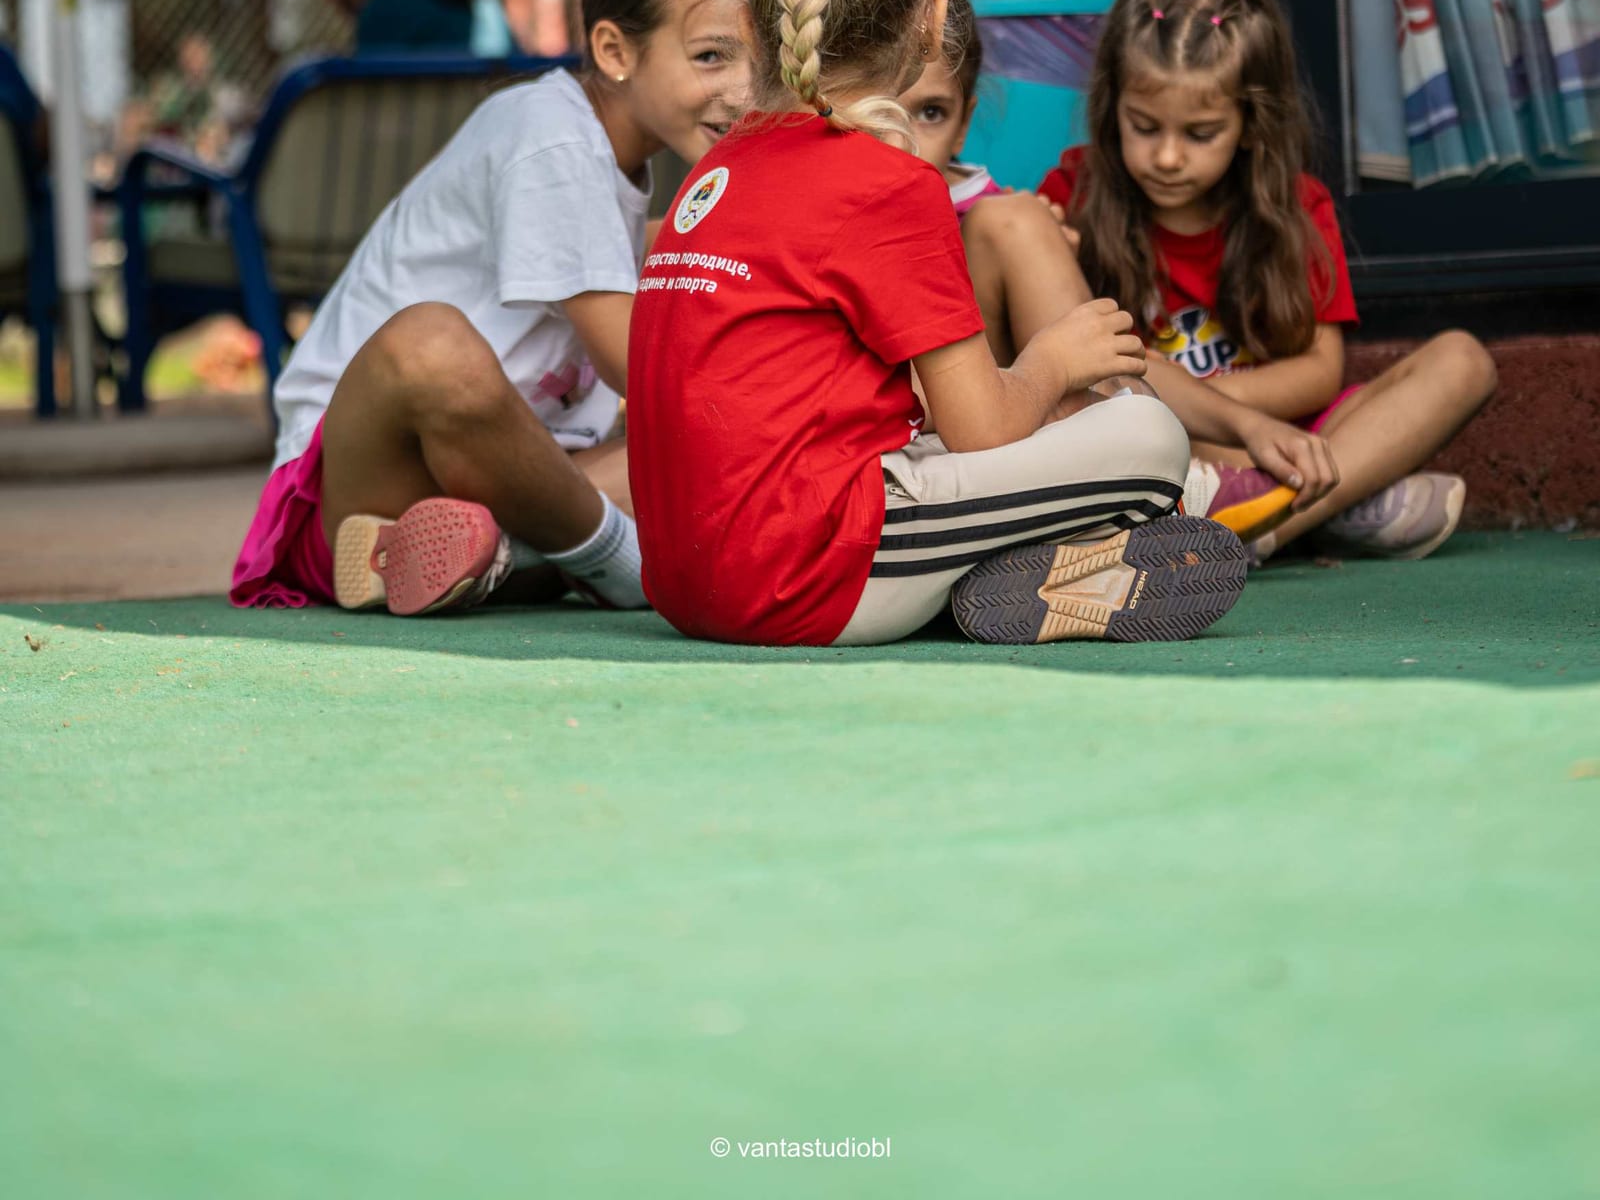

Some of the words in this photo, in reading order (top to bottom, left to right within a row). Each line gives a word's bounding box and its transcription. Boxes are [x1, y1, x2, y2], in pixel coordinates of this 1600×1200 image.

[680, 252, 752, 281] породице,
[666, 277, 674, 290] и
[674, 277, 718, 294] спорта
[1174, 338, 1239, 373] UP
[1129, 570, 1149, 610] HEAD
